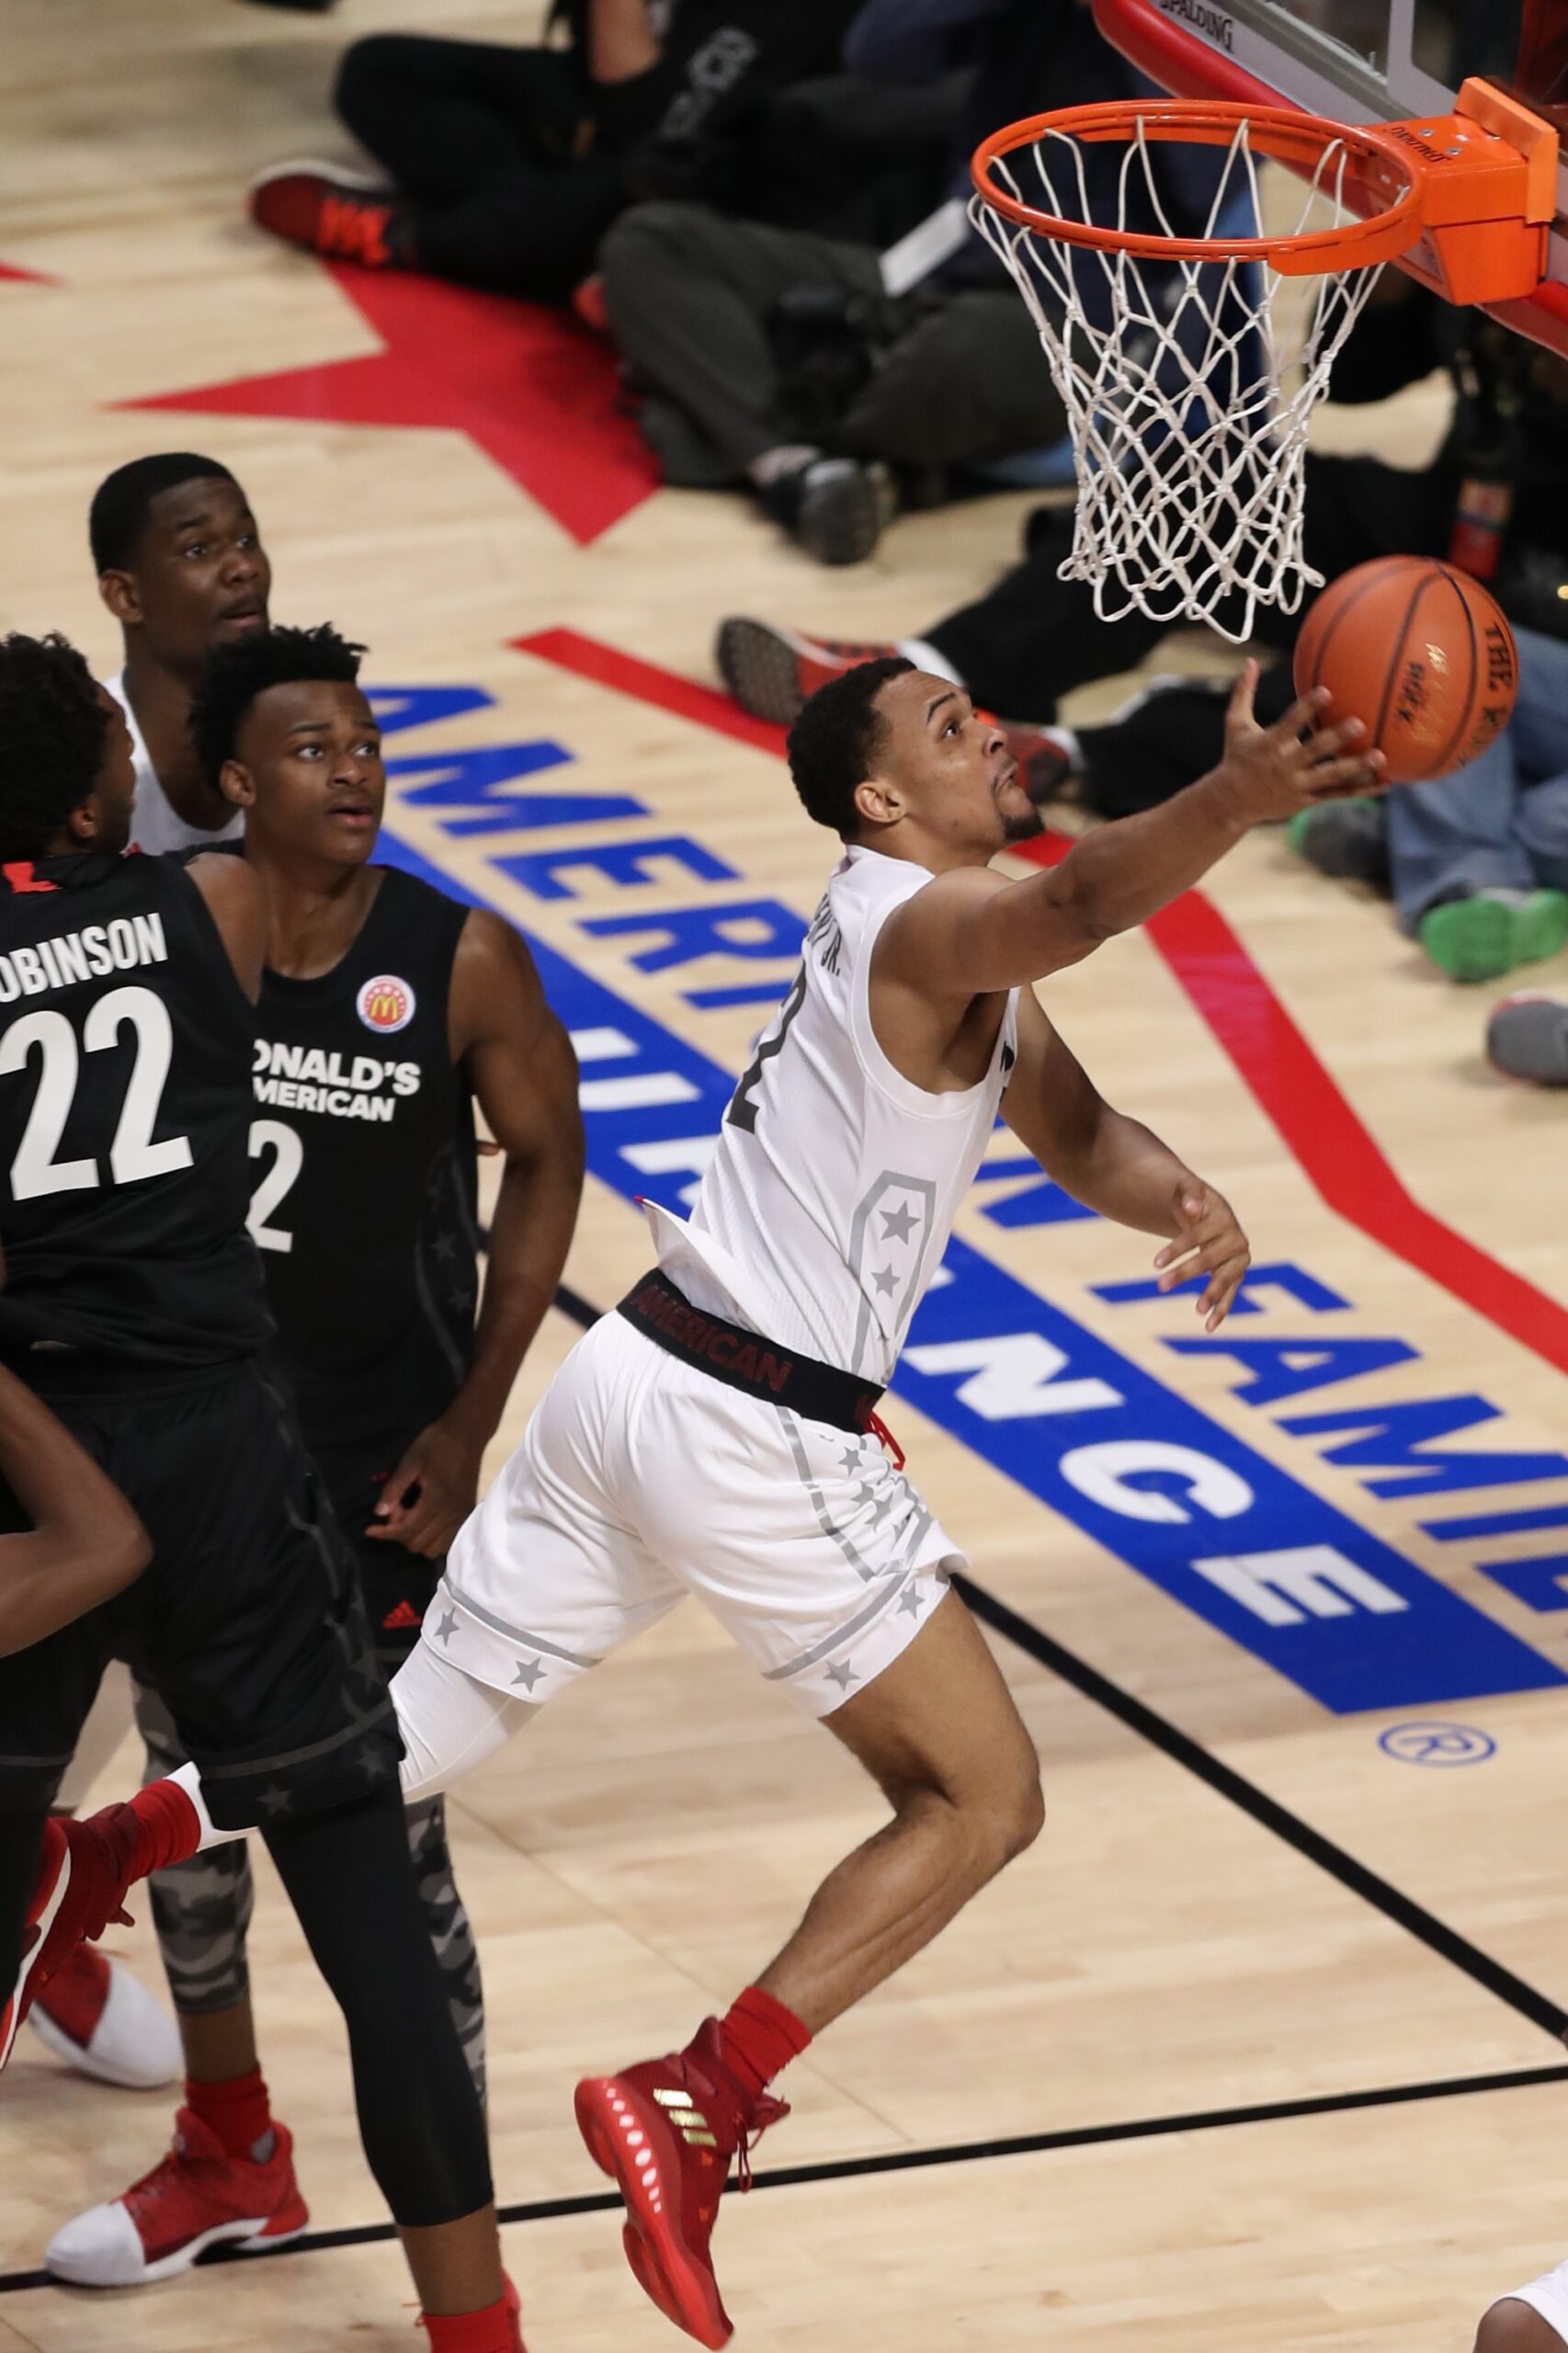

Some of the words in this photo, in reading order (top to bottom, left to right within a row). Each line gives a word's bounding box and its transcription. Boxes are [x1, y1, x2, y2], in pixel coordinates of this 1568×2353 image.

[1484, 620, 1514, 691] THE
[0, 986, 194, 1201] 22
[244, 1120, 304, 1253] 2
